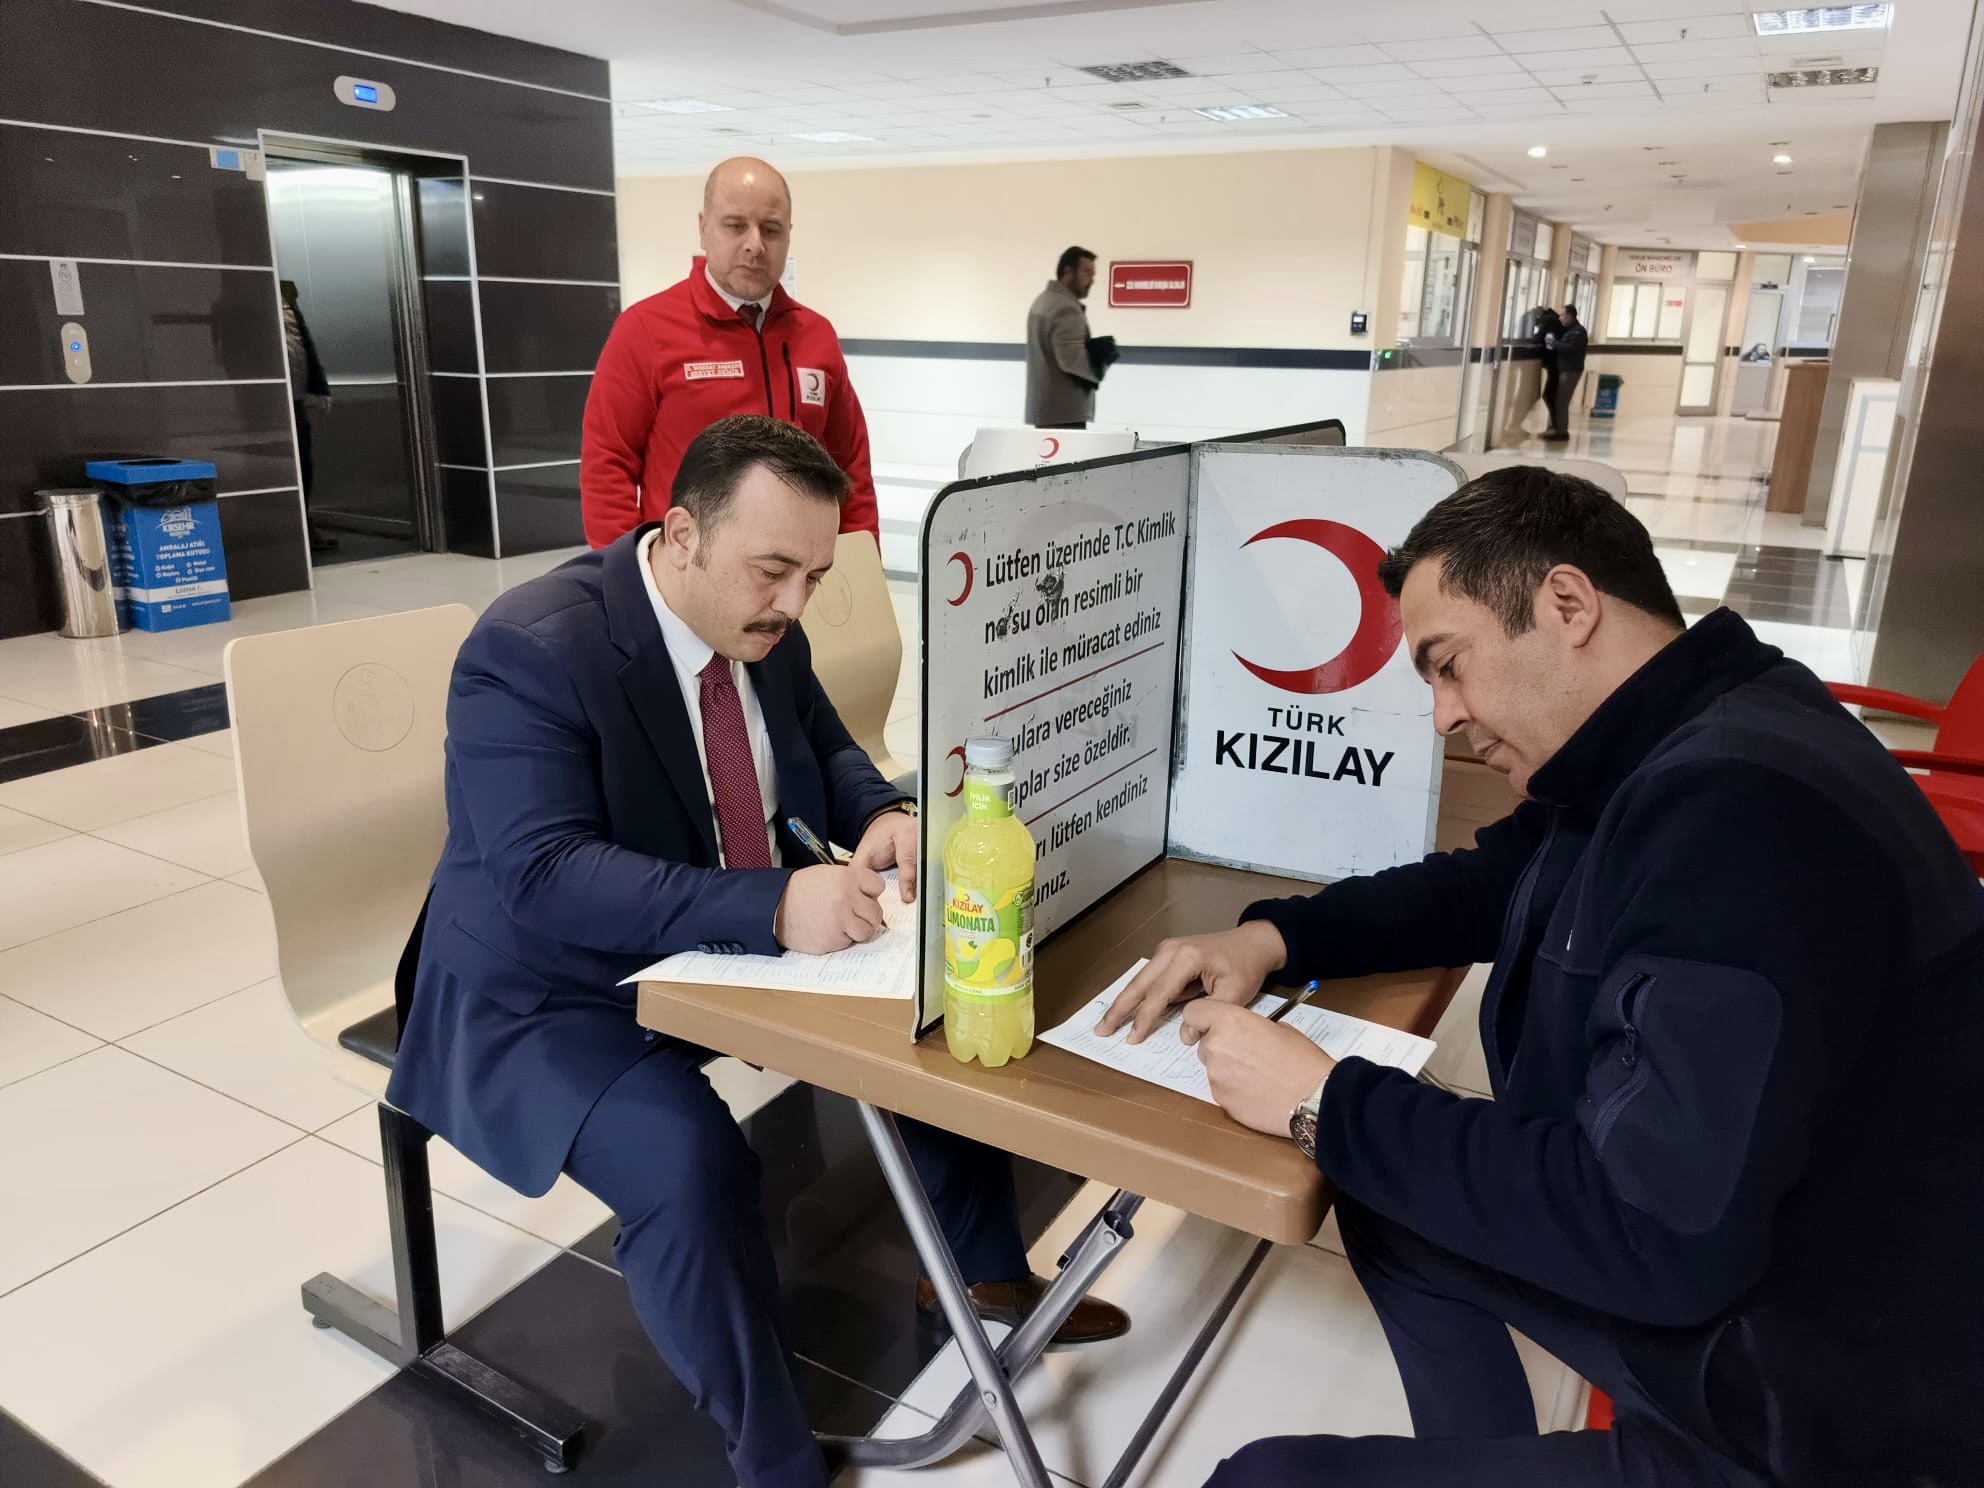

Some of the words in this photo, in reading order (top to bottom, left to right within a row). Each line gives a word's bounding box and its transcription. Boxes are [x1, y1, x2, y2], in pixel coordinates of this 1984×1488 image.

[986, 548, 1041, 588] Lütfen
[1045, 528, 1111, 571] üzerinde
[1114, 522, 1134, 550] T.C
[1137, 510, 1176, 545] Kimlik
[1073, 572, 1122, 614] resimli
[1125, 567, 1143, 596] bir
[984, 653, 1037, 700] kimlik
[1040, 646, 1058, 677] ile
[1062, 623, 1121, 668] müracat
[1124, 606, 1162, 642] ediniz
[1011, 722, 1051, 757] ulara
[1055, 678, 1132, 734] vereceğiniz
[1267, 704, 1347, 737] TÜRK
[1053, 752, 1080, 783] size
[1084, 723, 1131, 767] özeldir.
[1215, 729, 1396, 788] KIZILAY
[1050, 811, 1093, 852] lütfen
[1095, 773, 1149, 823] kendiniz
[947, 906, 996, 933] LİMONATA
[952, 898, 984, 914] KIZILAY
